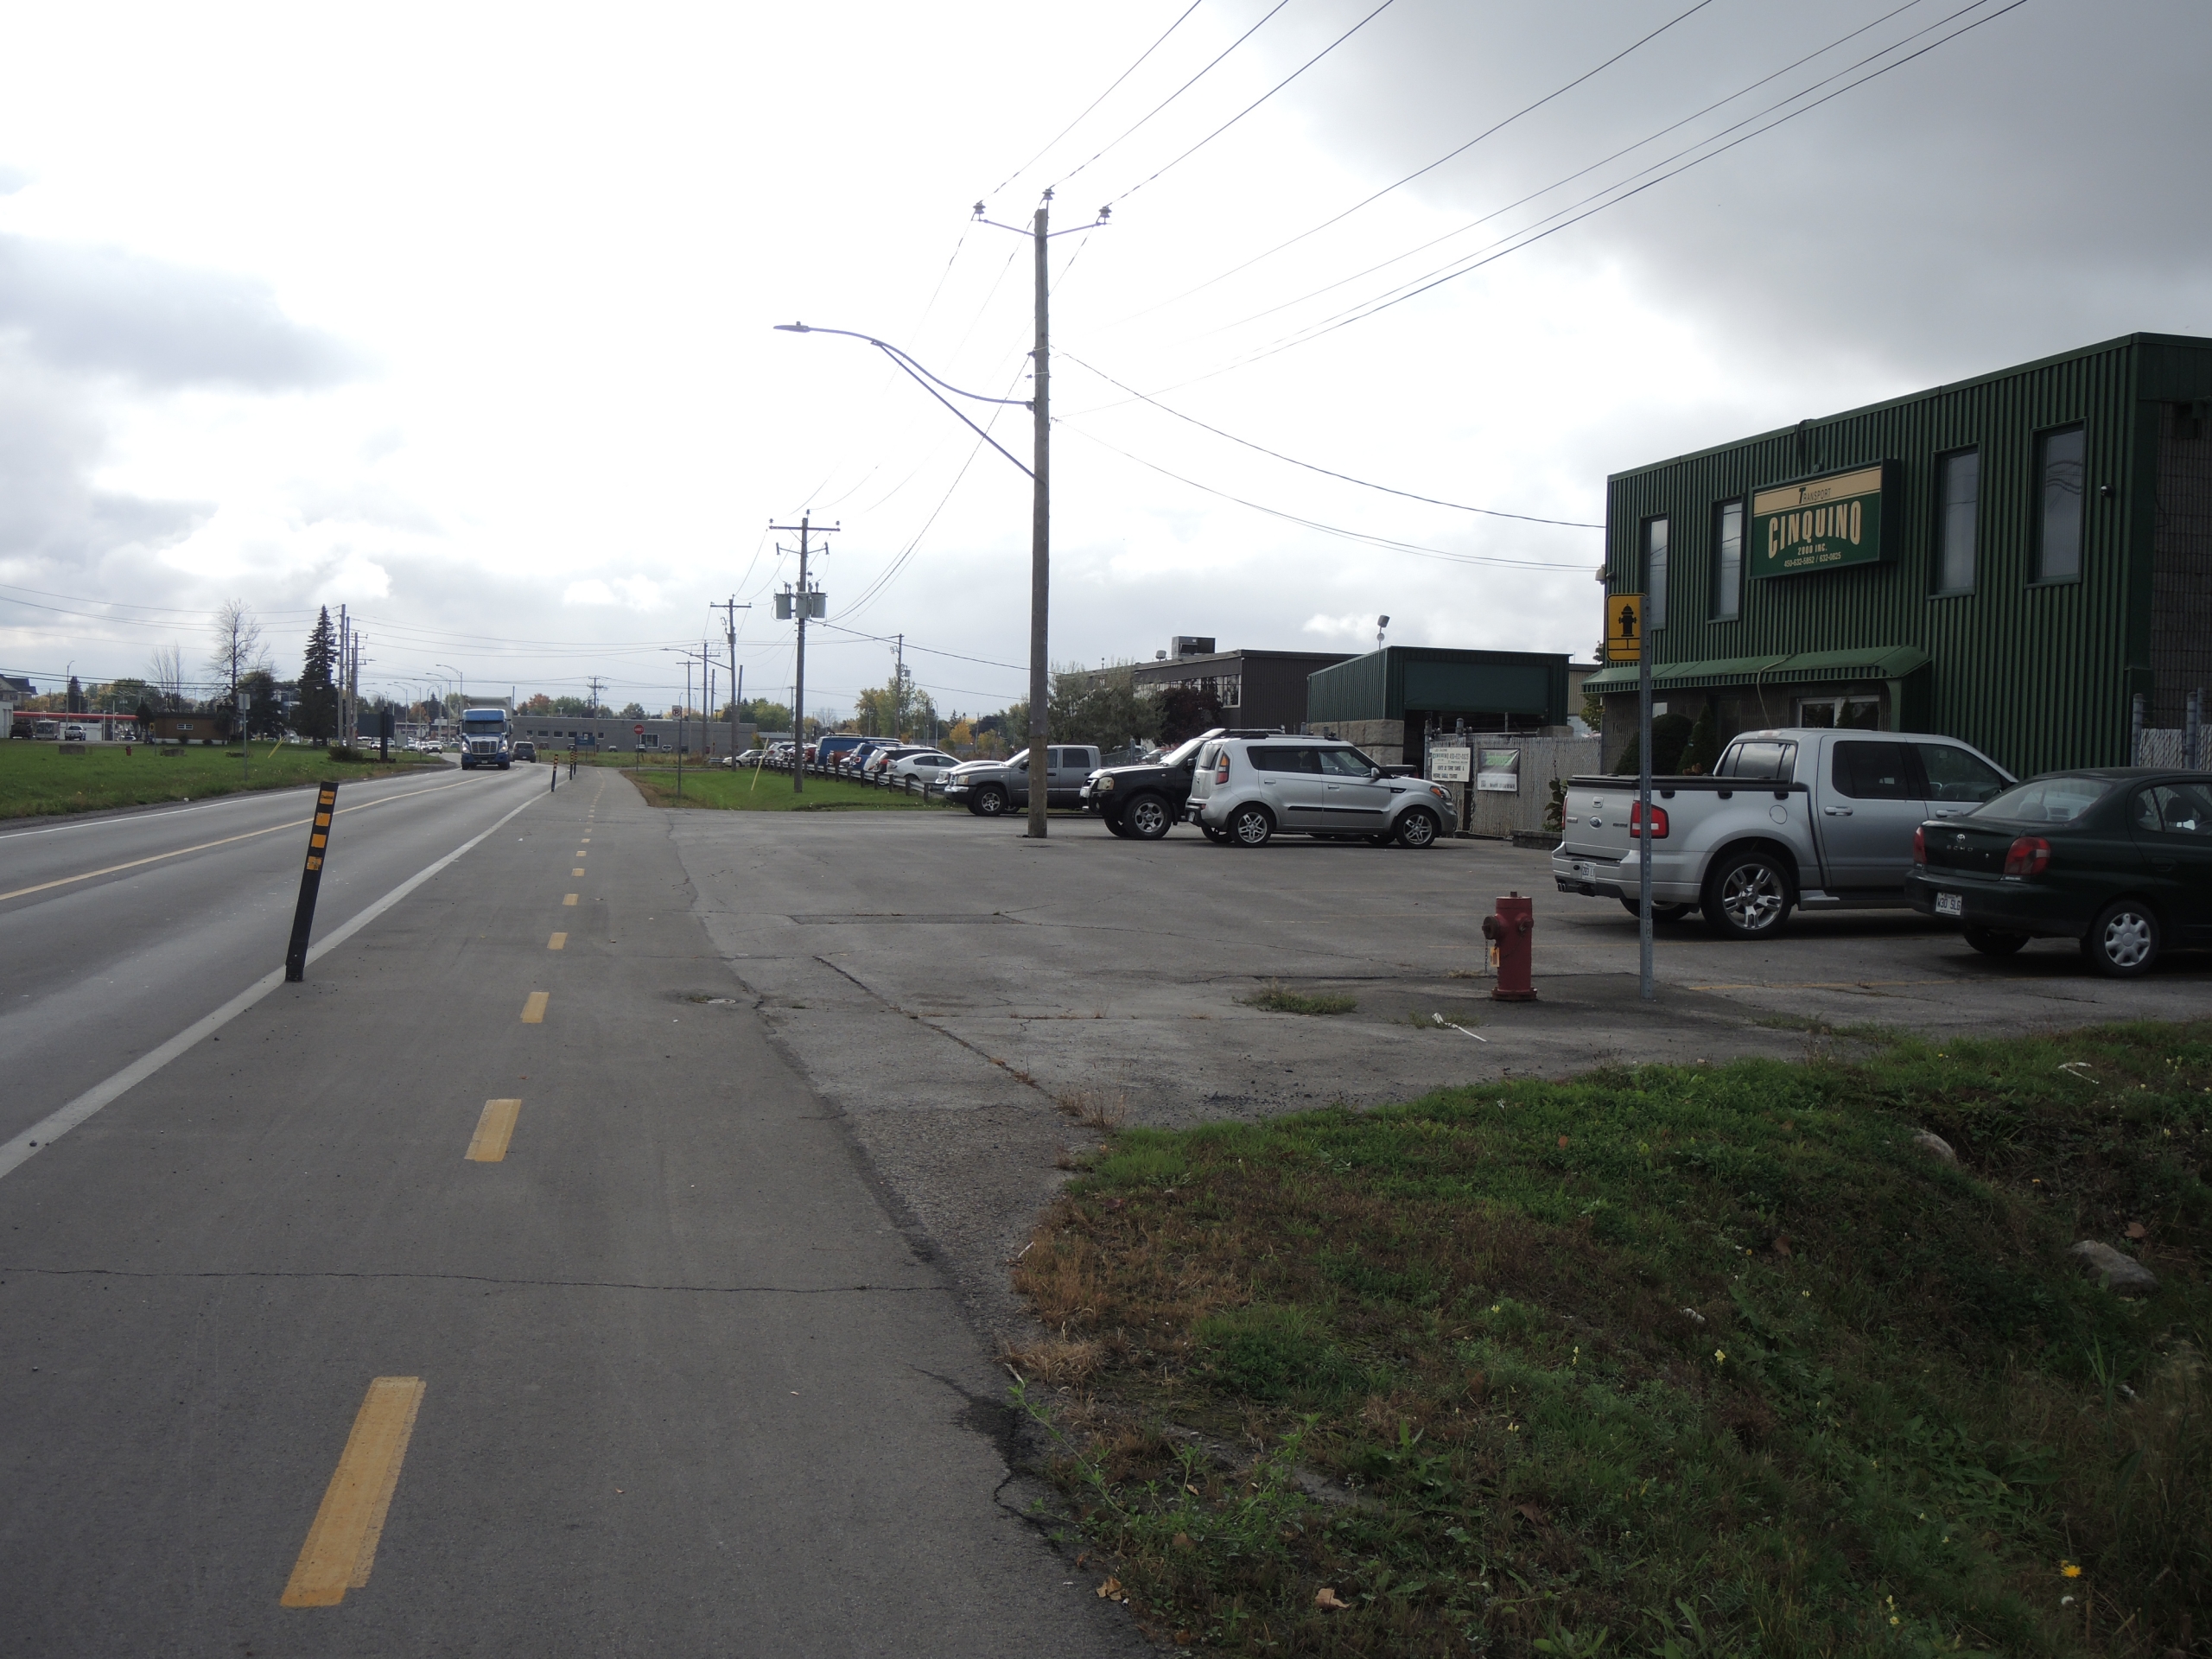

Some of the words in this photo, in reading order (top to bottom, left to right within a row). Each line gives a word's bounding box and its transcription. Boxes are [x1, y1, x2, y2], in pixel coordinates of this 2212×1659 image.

[1768, 500, 1861, 559] CINQUINO
[1797, 545, 1813, 556] 2000
[1815, 543, 1827, 553] INC.
